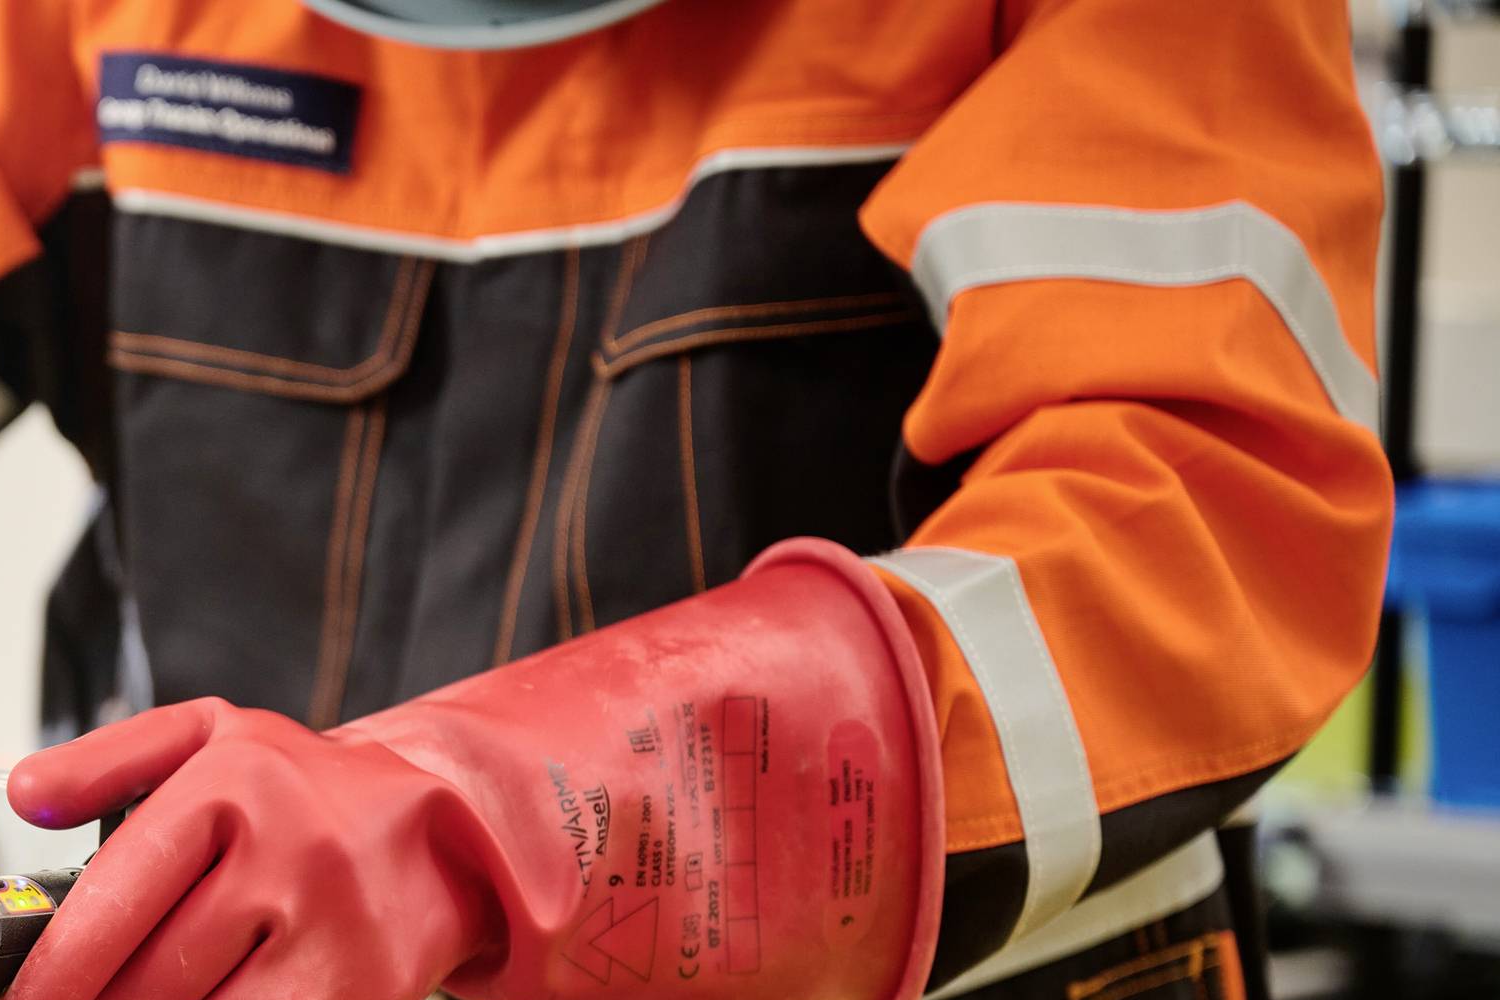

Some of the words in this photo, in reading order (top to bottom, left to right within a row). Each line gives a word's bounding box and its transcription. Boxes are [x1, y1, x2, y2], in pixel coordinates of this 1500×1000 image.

[583, 786, 609, 857] Ansell
[713, 807, 722, 840] CODE
[651, 851, 663, 887] CLASS
[666, 821, 676, 887] CATEGORY
[608, 874, 625, 887] 9
[636, 869, 647, 888] EN
[678, 943, 700, 980] CE
